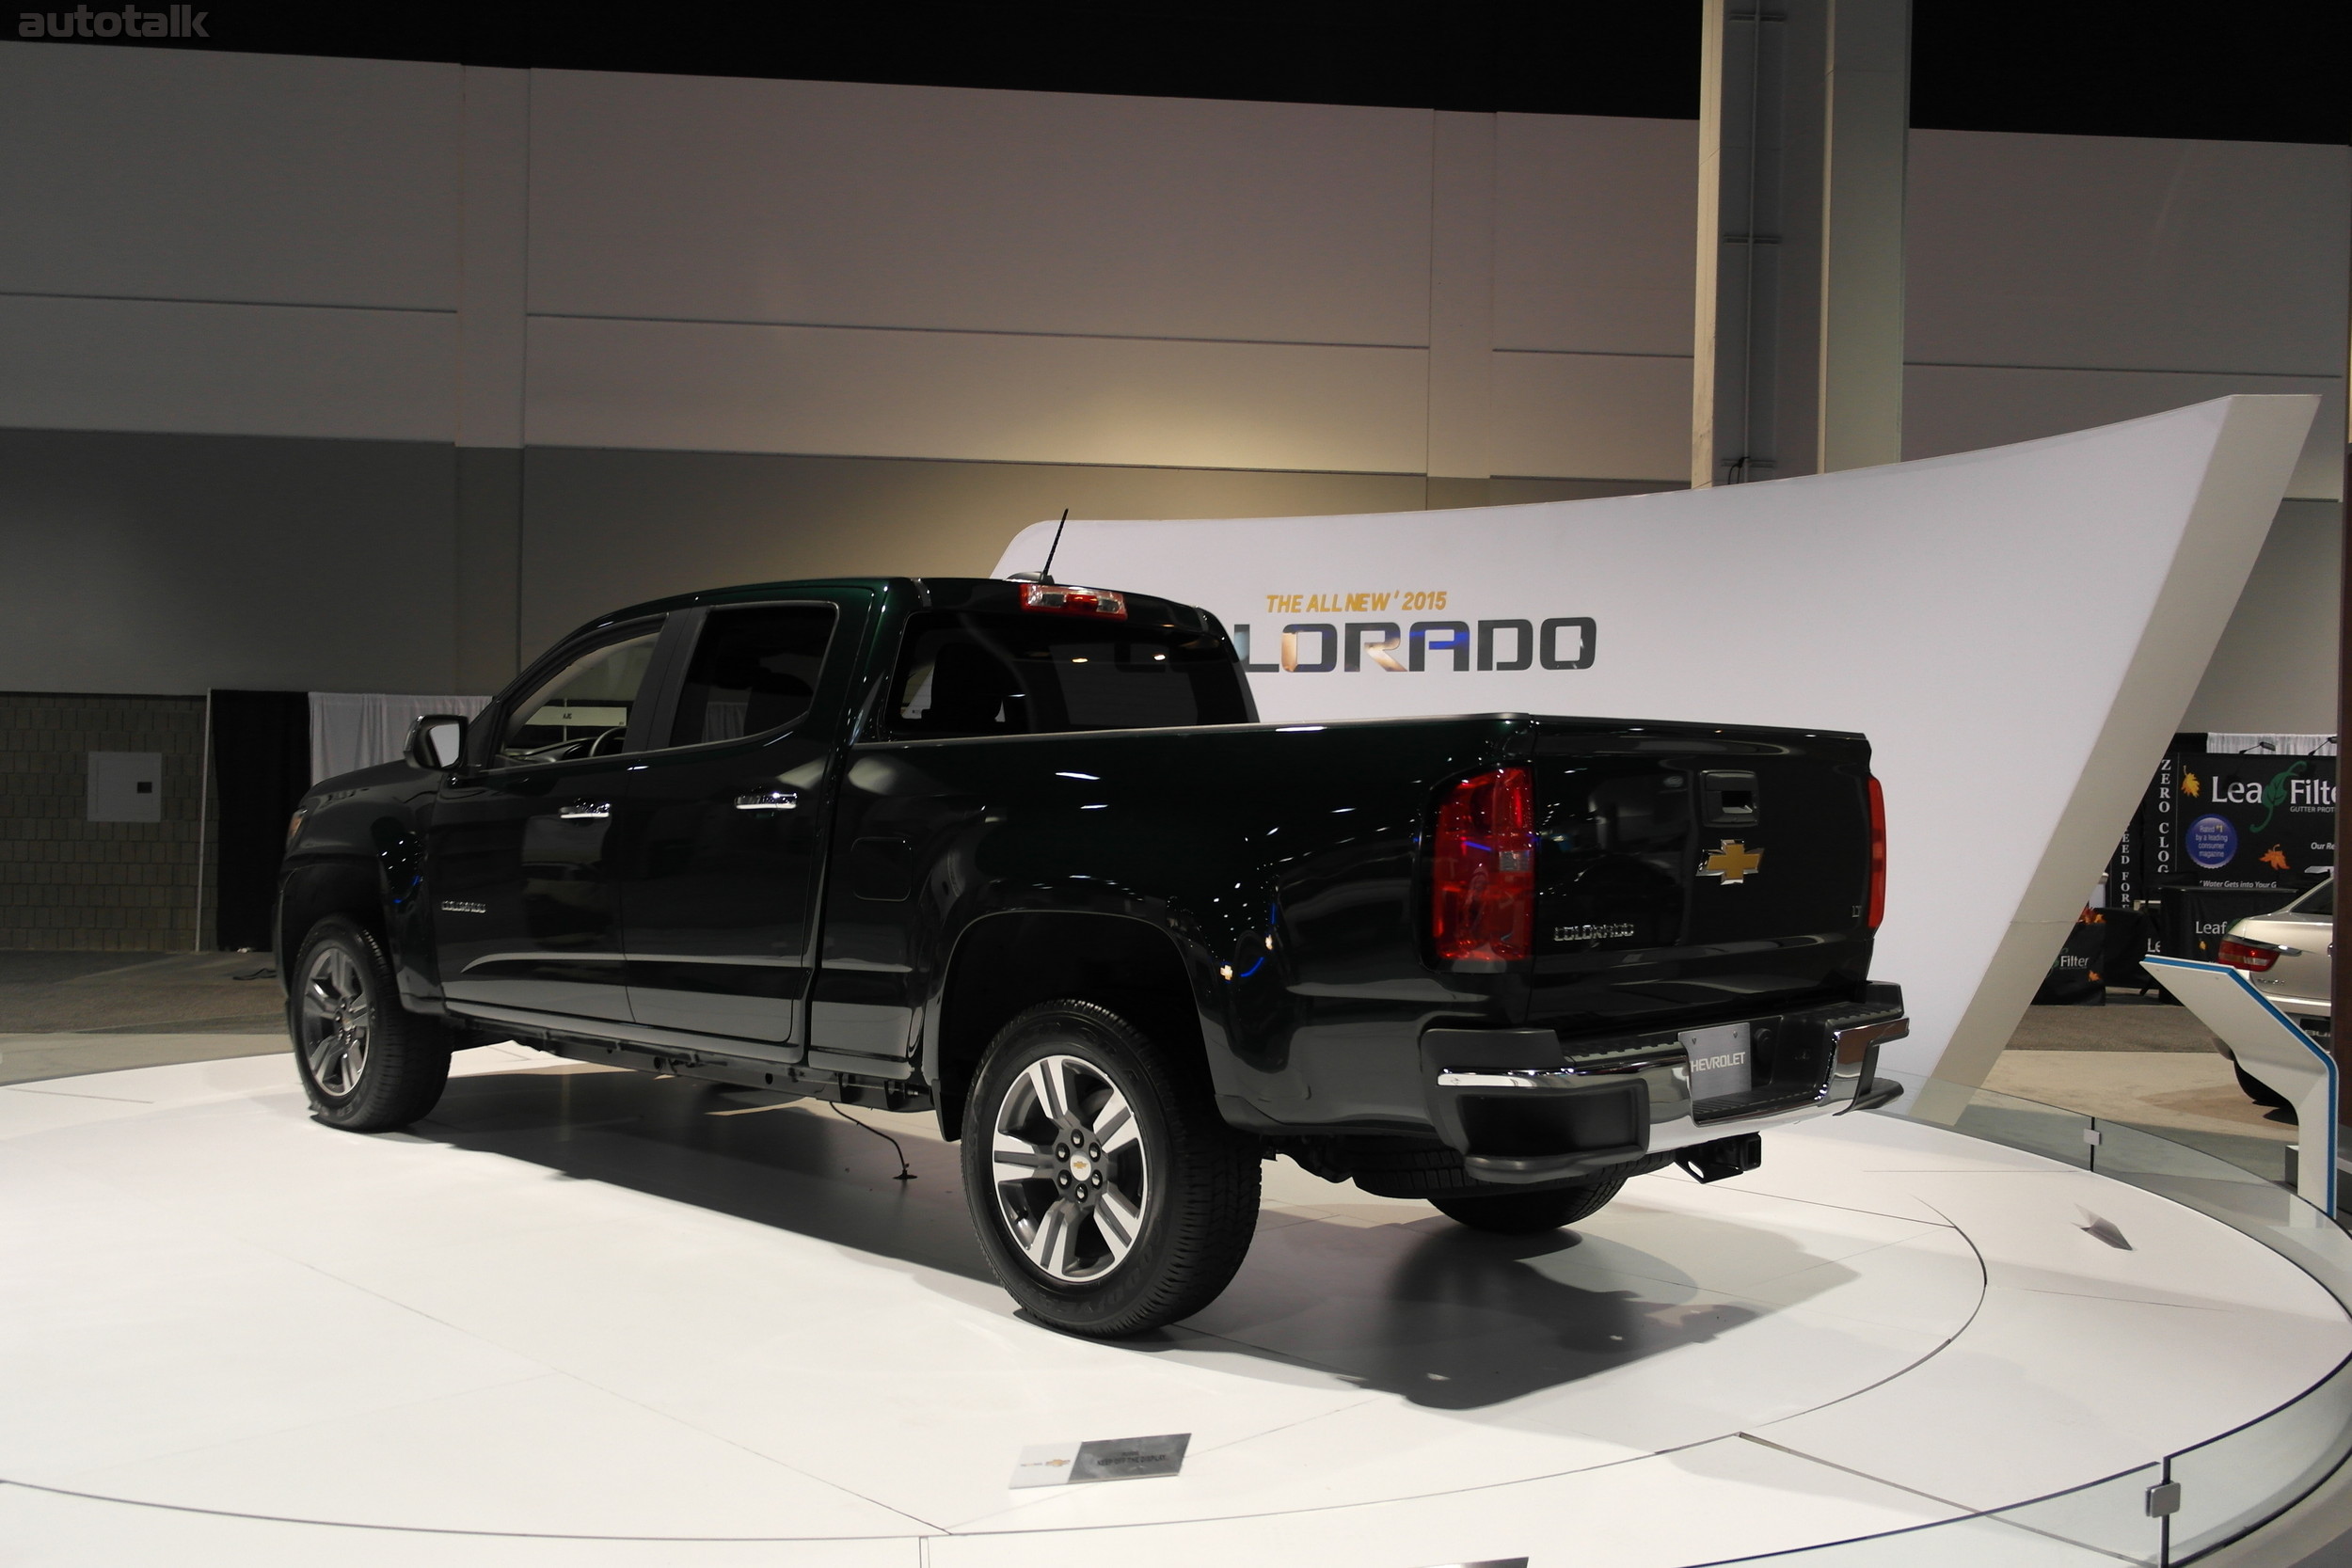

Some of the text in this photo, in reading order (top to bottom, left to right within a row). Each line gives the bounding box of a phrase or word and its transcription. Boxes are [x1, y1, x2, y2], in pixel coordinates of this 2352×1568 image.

[1266, 594, 1304, 613] THE
[1306, 594, 1343, 613] ALL
[1344, 593, 1390, 612] NEW
[2158, 759, 2171, 813] ZERO
[2195, 834, 2202, 843] by
[2208, 834, 2228, 843] leading
[1554, 923, 1634, 942] COLORADO
[2195, 921, 2228, 935] Leaf
[2059, 955, 2090, 968] Filter
[1690, 1052, 1746, 1073] HEVROLET
